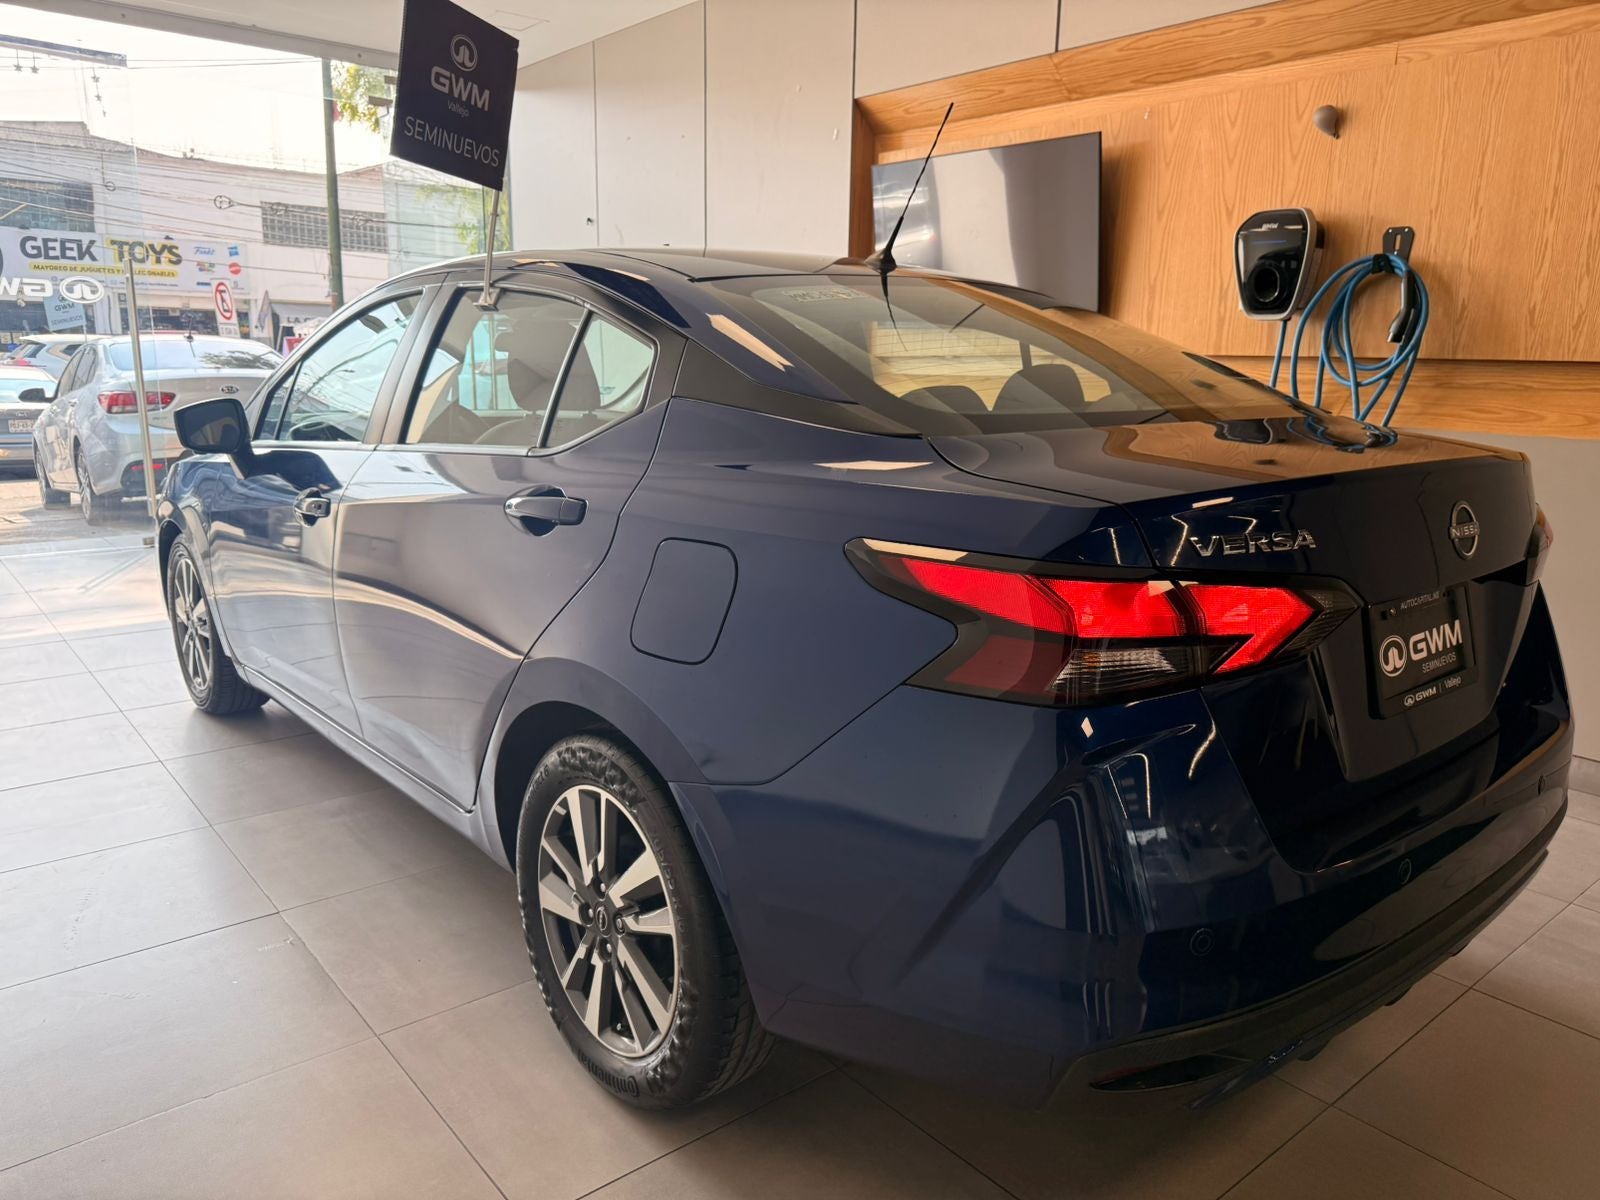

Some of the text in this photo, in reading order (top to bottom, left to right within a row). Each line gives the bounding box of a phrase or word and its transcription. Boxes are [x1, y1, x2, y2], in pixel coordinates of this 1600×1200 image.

[430, 65, 490, 112] GWM
[447, 100, 470, 118] Vallejo
[404, 115, 500, 167] SEMINUEVOS
[20, 235, 184, 266] GEEK TOYS
[32, 264, 69, 272] MAYOREO
[1190, 529, 1317, 557] VERSA
[1451, 523, 1479, 538] NISS
[1409, 619, 1463, 661] GWM
[1421, 651, 1457, 673] SEMINUEVOS
[1415, 686, 1437, 702] GWM
[577, 1048, 641, 1098] Continental
